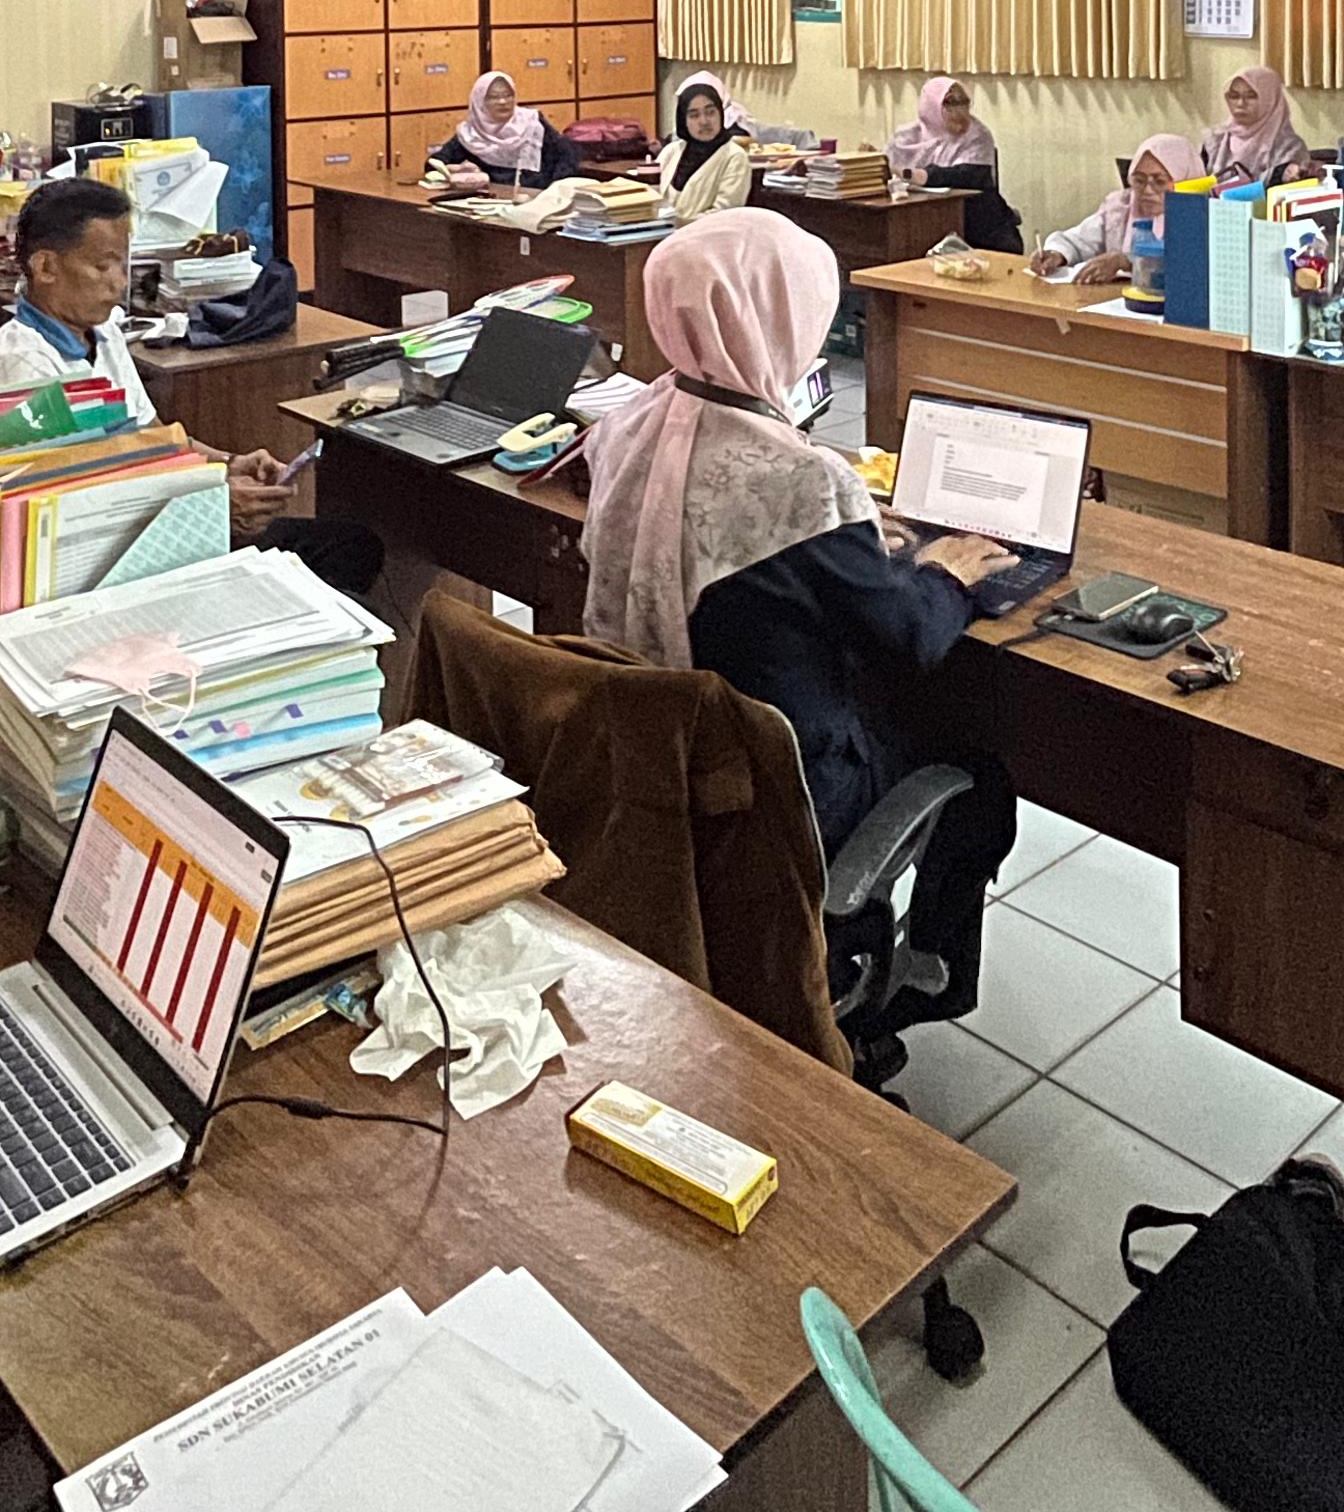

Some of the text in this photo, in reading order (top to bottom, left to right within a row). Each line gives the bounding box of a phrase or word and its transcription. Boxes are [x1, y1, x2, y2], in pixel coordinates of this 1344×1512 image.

[177, 1426, 211, 1453] SDN
[213, 1378, 297, 1432] SUKABUMI
[298, 1338, 364, 1381] SELATAN
[364, 1328, 381, 1343] 01
